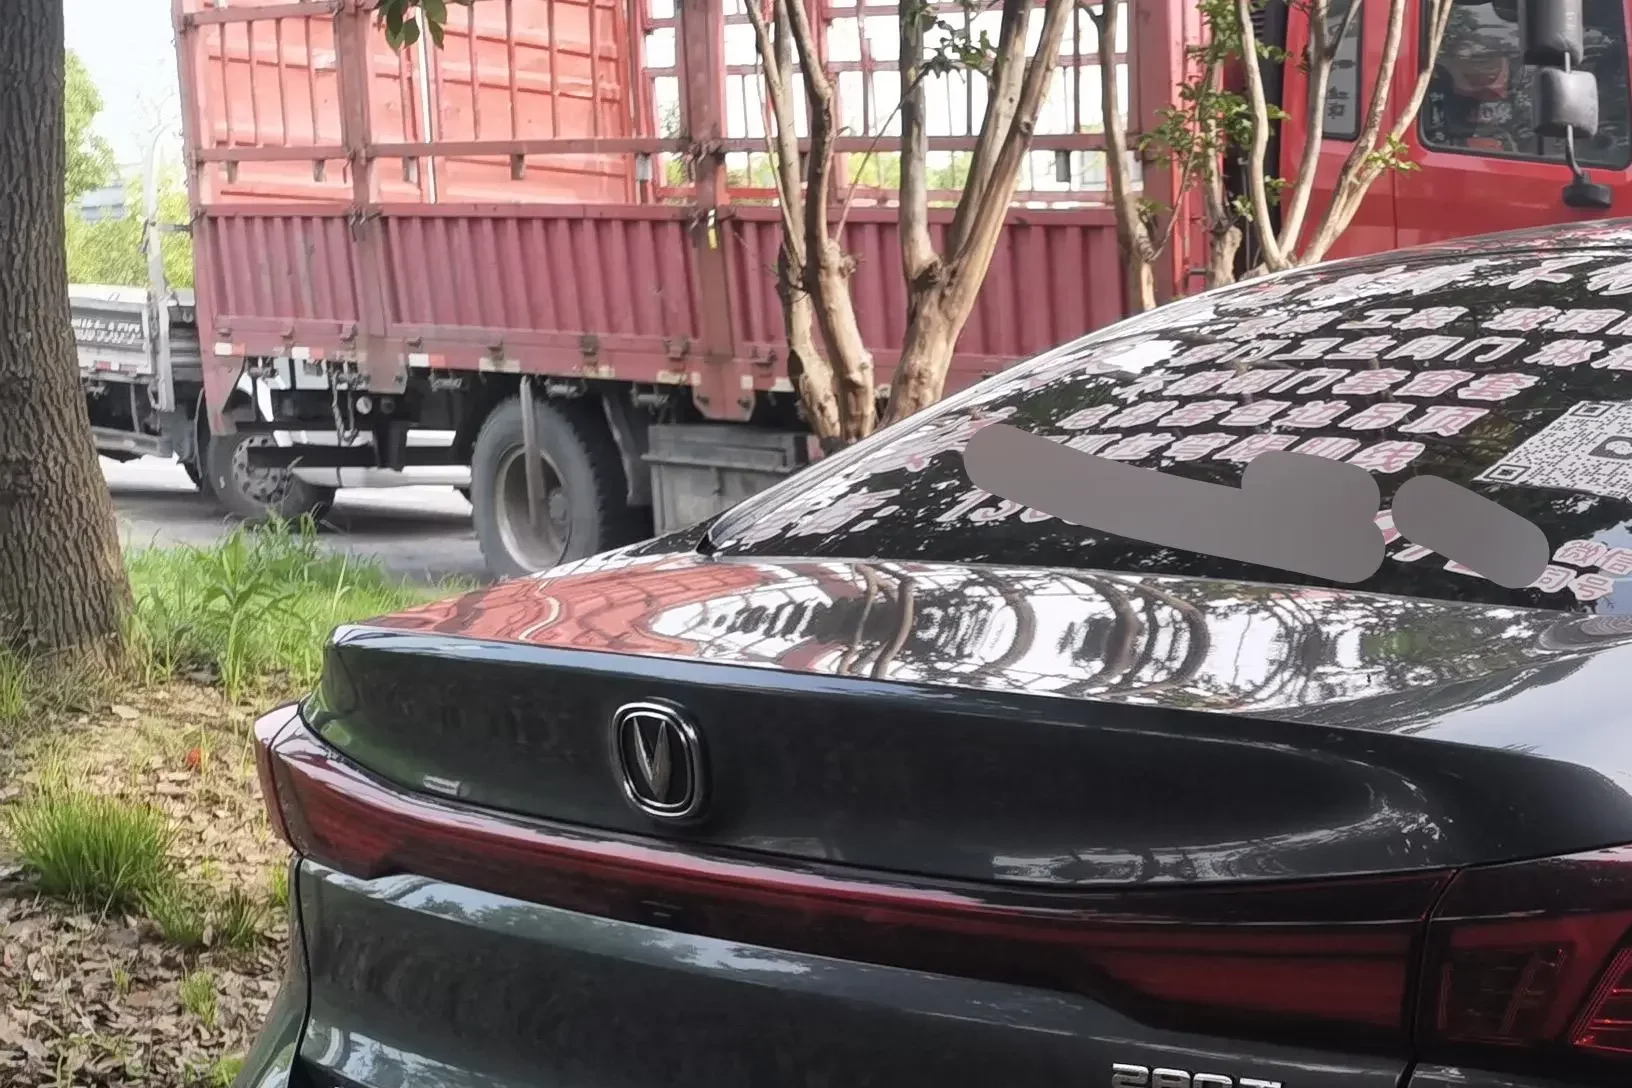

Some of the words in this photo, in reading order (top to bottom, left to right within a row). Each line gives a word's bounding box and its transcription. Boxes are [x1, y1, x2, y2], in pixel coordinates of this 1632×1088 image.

[1336, 306, 1469, 331] 工装
[1055, 399, 1490, 437] 电梯套包边吊顶
[1529, 564, 1615, 601] 同号
